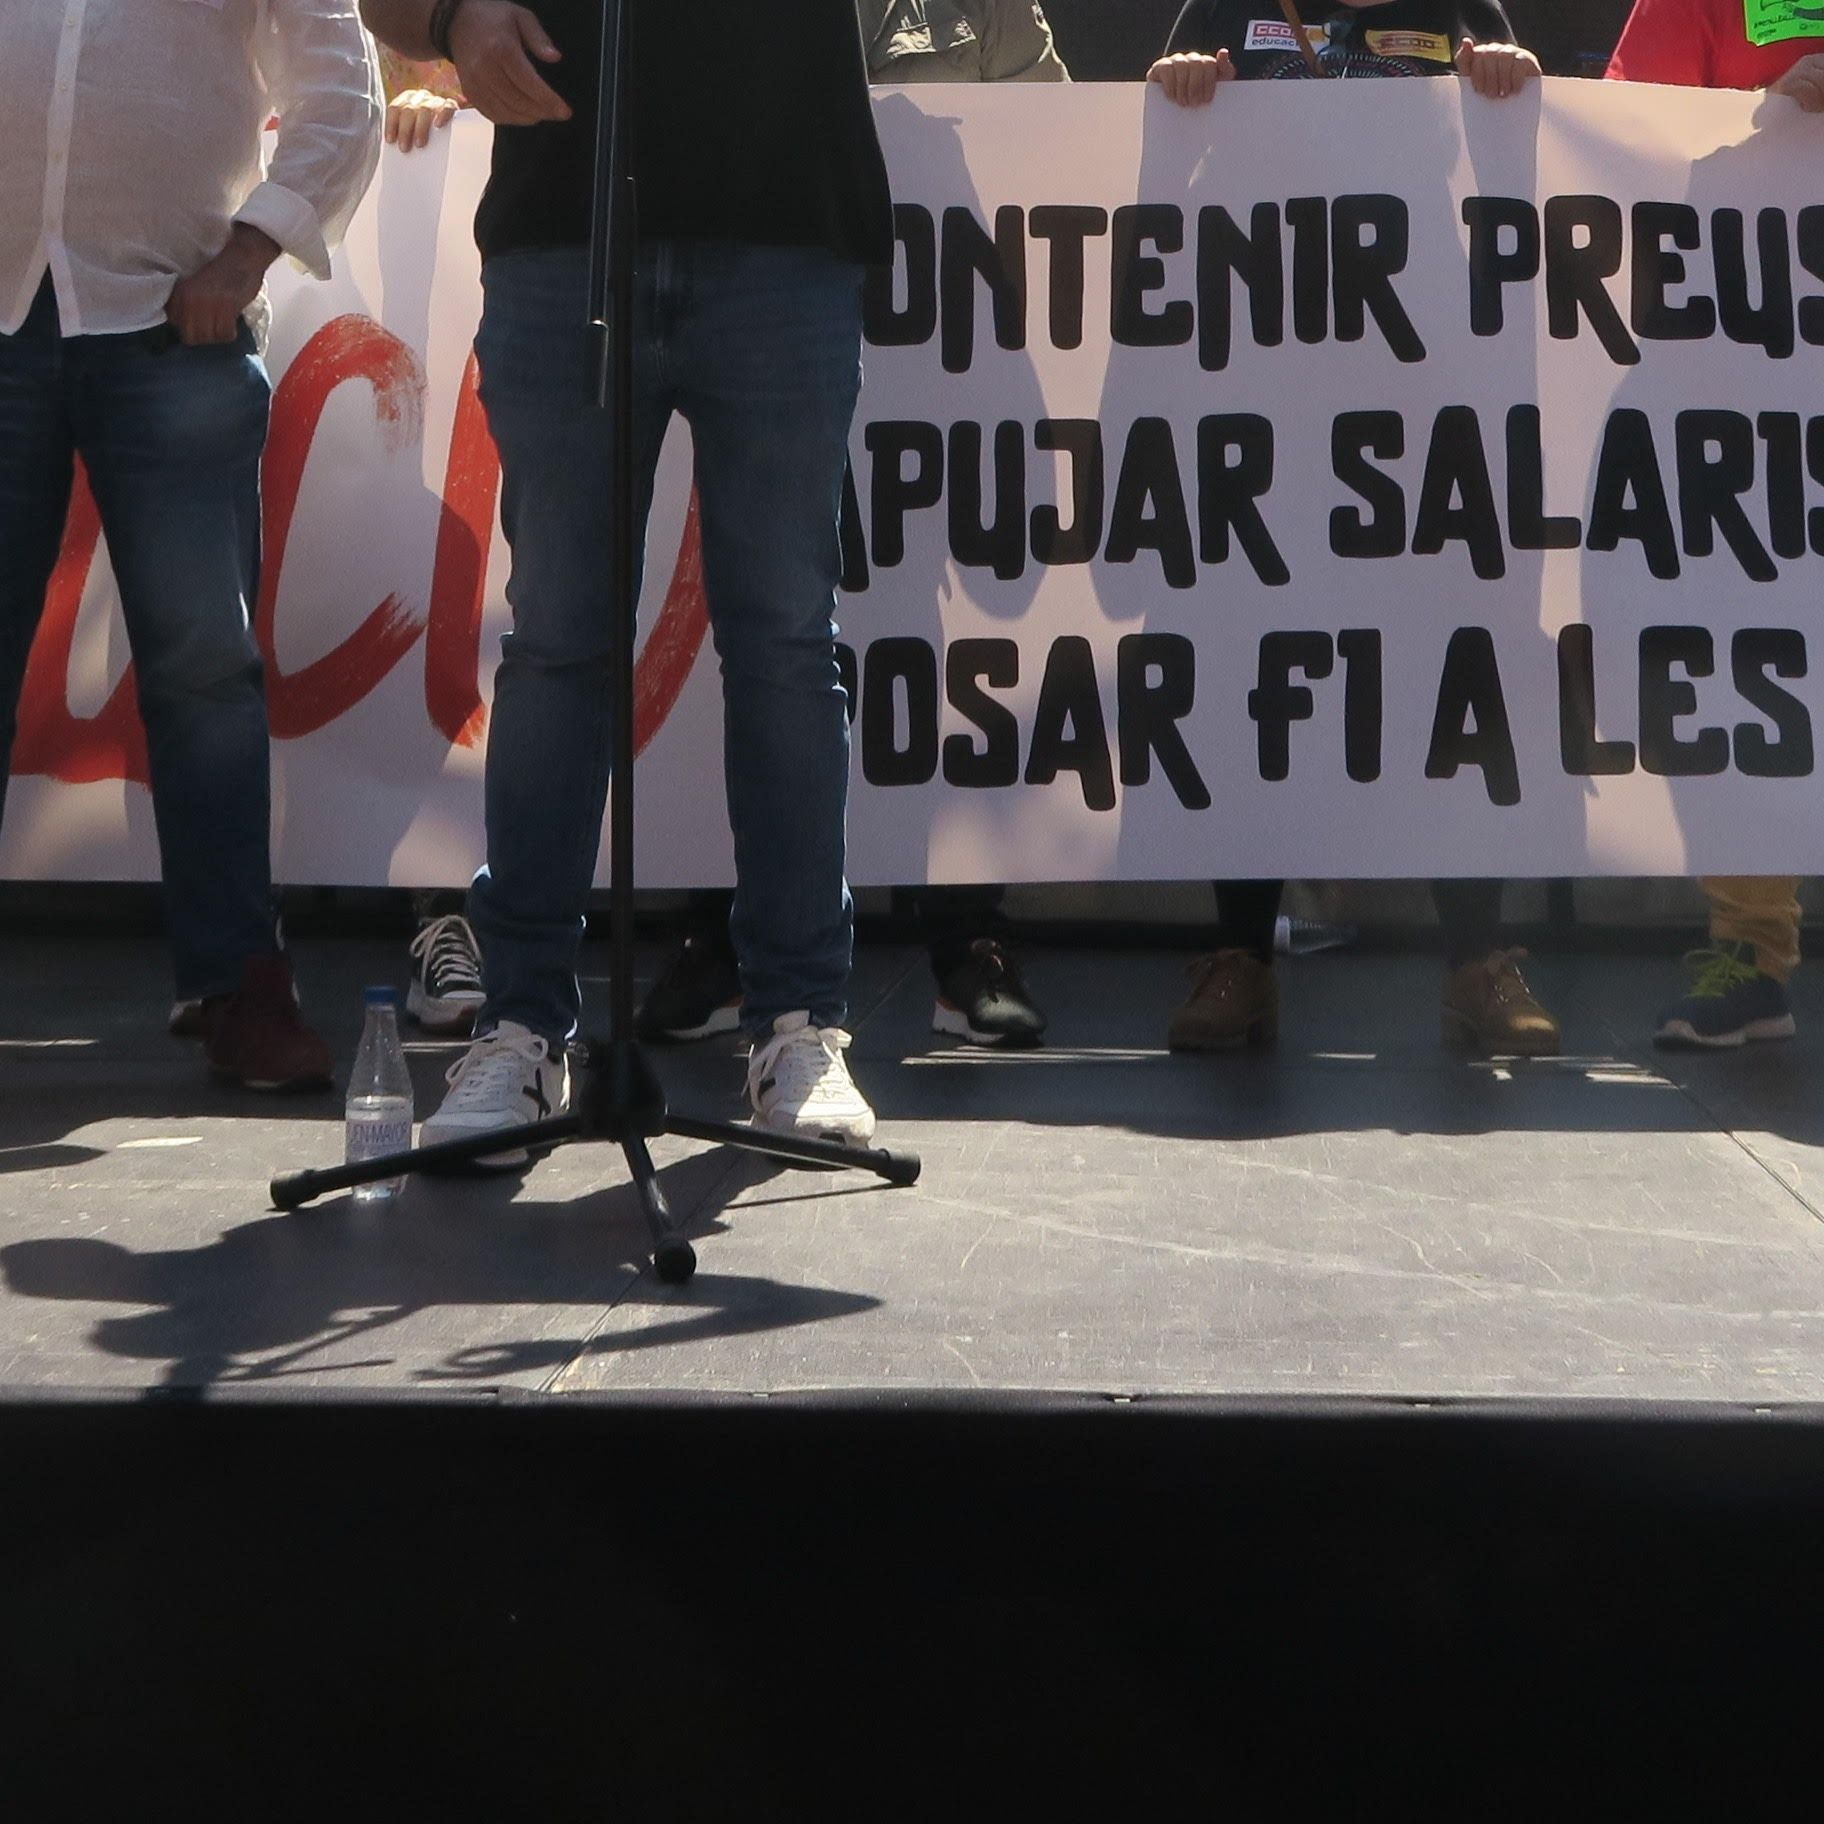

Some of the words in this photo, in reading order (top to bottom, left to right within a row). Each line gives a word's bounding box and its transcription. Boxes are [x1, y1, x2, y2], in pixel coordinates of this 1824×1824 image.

[1255, 25, 1296, 38] CCO
[863, 193, 1426, 373] ONTENIR
[841, 412, 1290, 593] PUJAR
[833, 632, 1212, 811] OSAR
[1247, 628, 1383, 782] FI
[1424, 625, 1521, 807] A
[1557, 623, 1815, 778] LES
